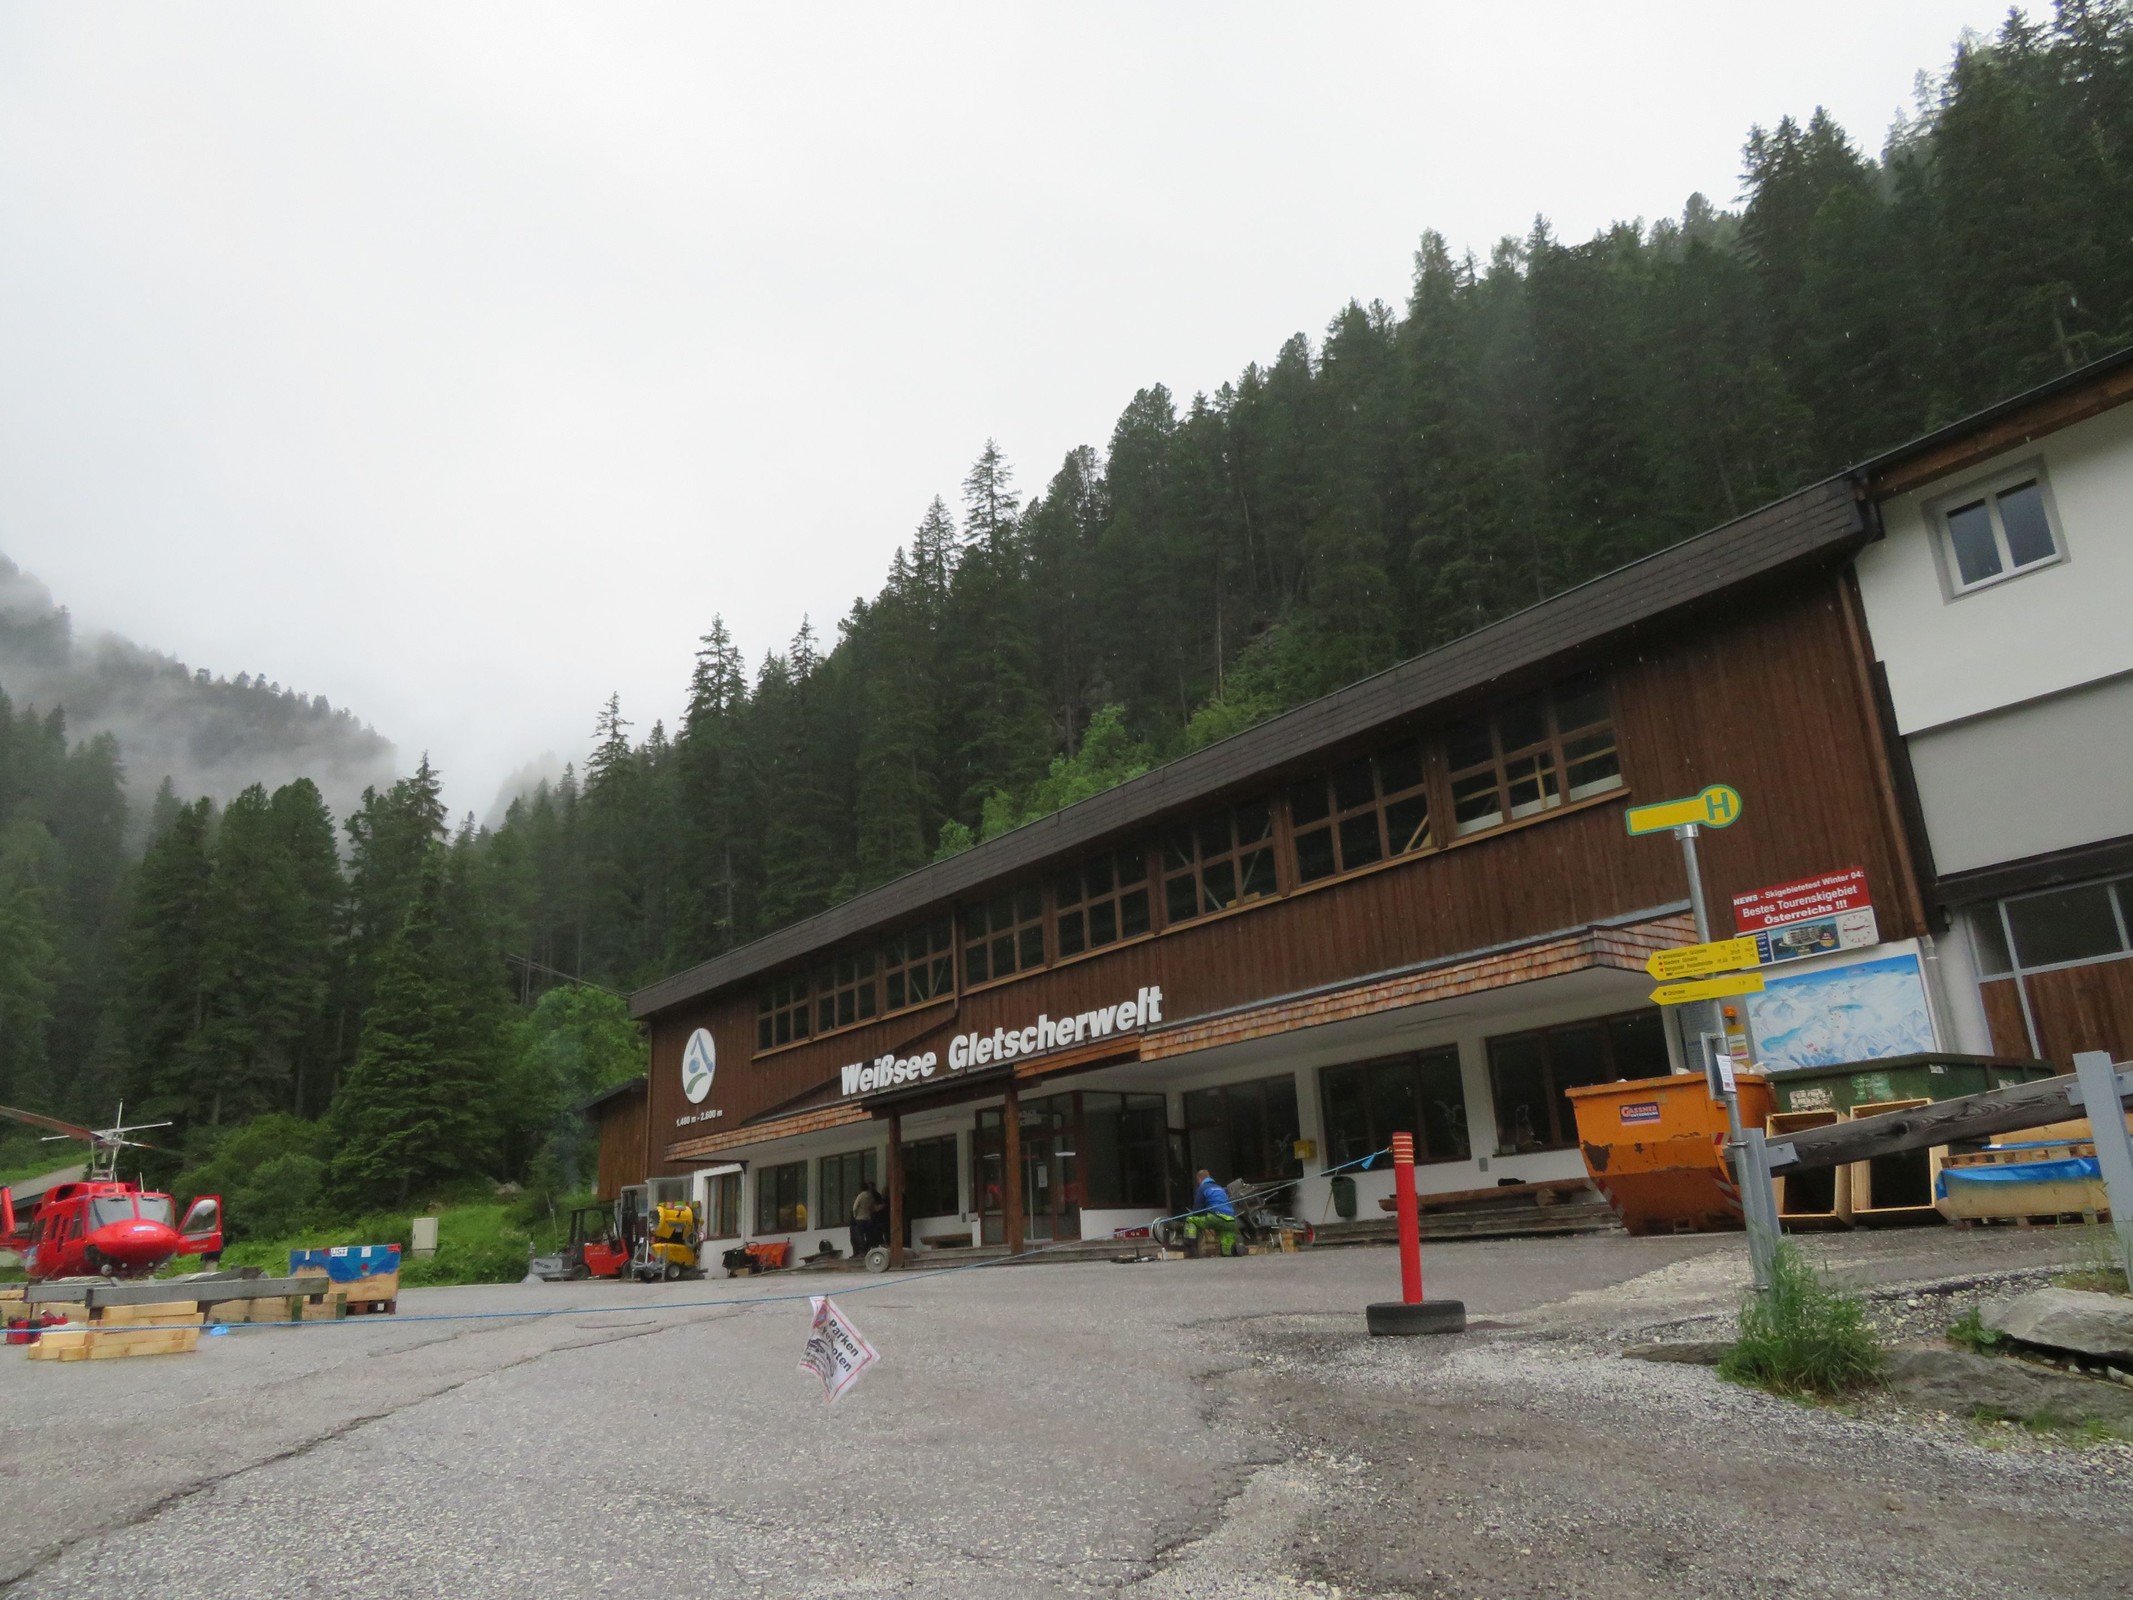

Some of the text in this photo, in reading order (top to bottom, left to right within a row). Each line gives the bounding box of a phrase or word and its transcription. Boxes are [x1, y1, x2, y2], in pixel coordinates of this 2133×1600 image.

[1706, 792, 1731, 820] H
[1733, 894, 1759, 906] NEWS
[1822, 875, 1849, 885] Winter
[1742, 884, 1858, 918] Bestes Tourenskigebiet
[1764, 899, 1848, 924] Österreichs !!!
[841, 985, 1163, 1096] Weißsee Gletscherwelt
[700, 1109, 717, 1121] 2.600
[829, 1318, 860, 1357] Parken
